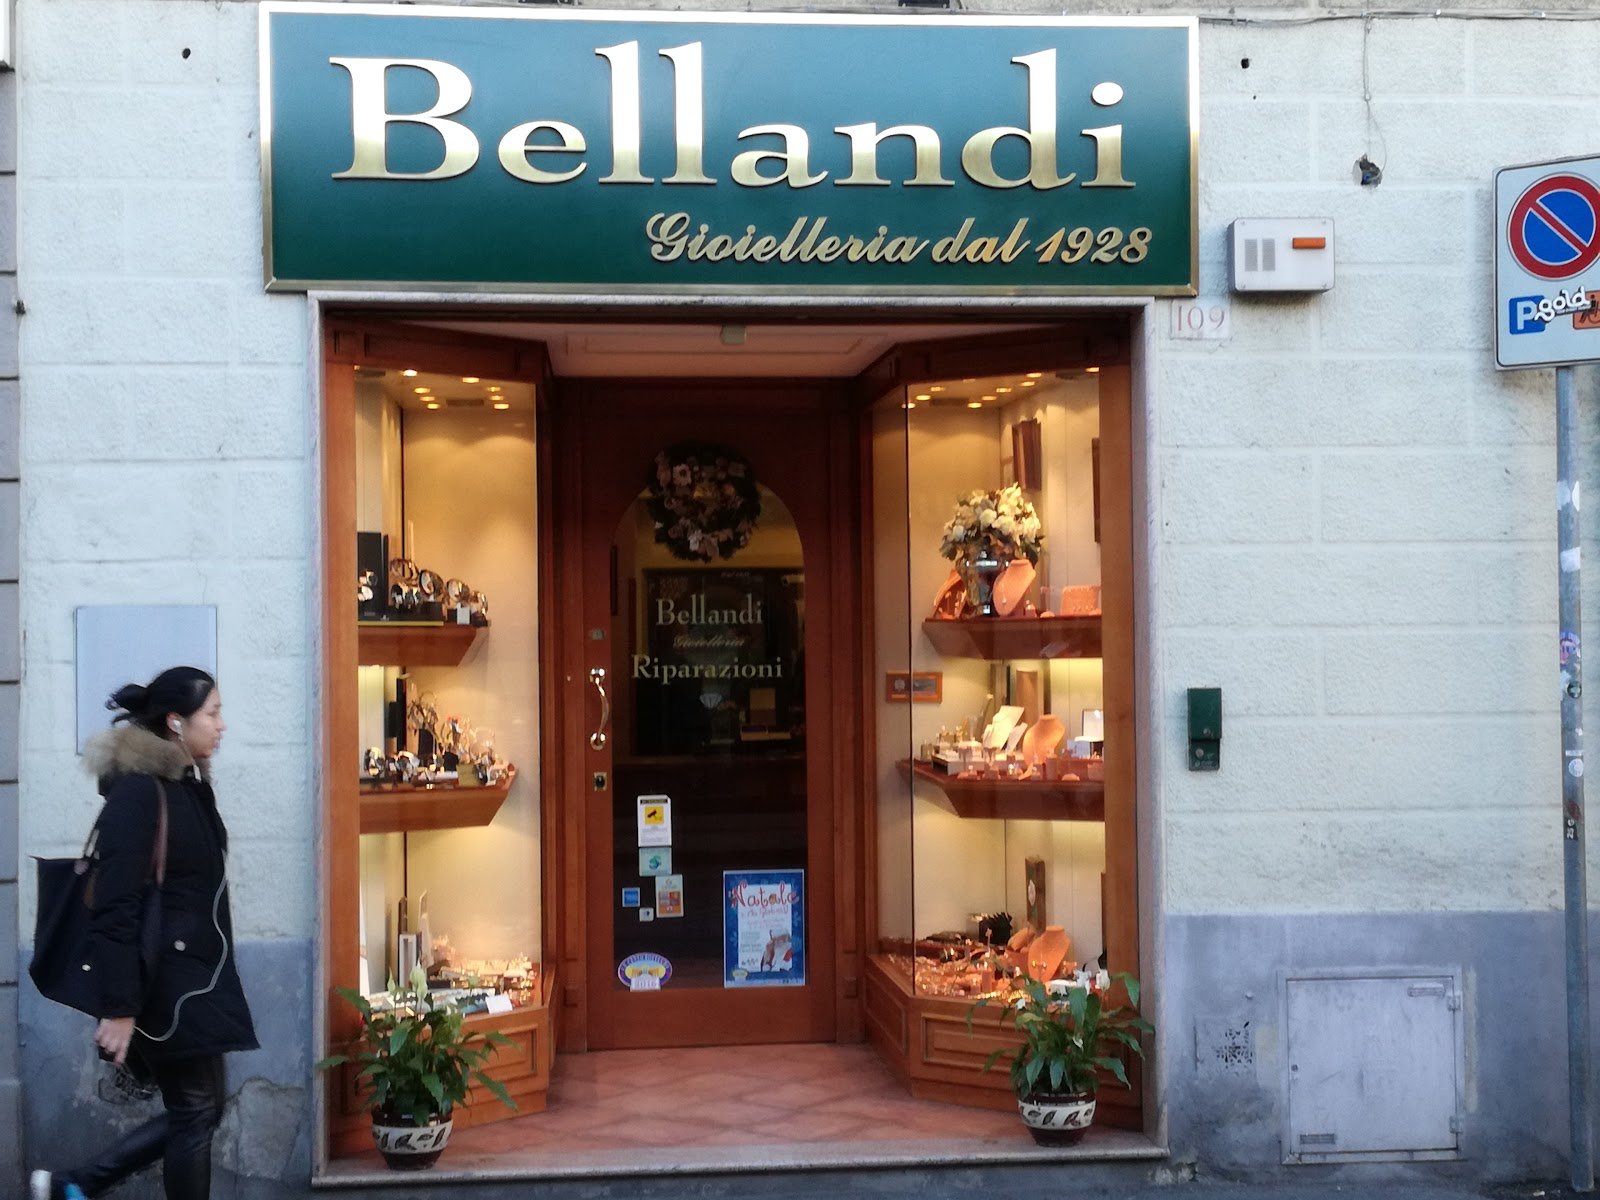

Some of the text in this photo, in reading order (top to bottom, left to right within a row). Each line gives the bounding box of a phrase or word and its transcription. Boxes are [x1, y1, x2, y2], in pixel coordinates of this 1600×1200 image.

[330, 40, 1136, 190] Bellandi
[646, 212, 1153, 265] Gioielleria dal 1928
[1177, 305, 1225, 331] 109
[1516, 301, 1537, 330] P
[1534, 286, 1591, 322] gold
[656, 594, 763, 626] Bellandi
[632, 654, 783, 684] Riparazioni
[730, 881, 800, 909] Natale
